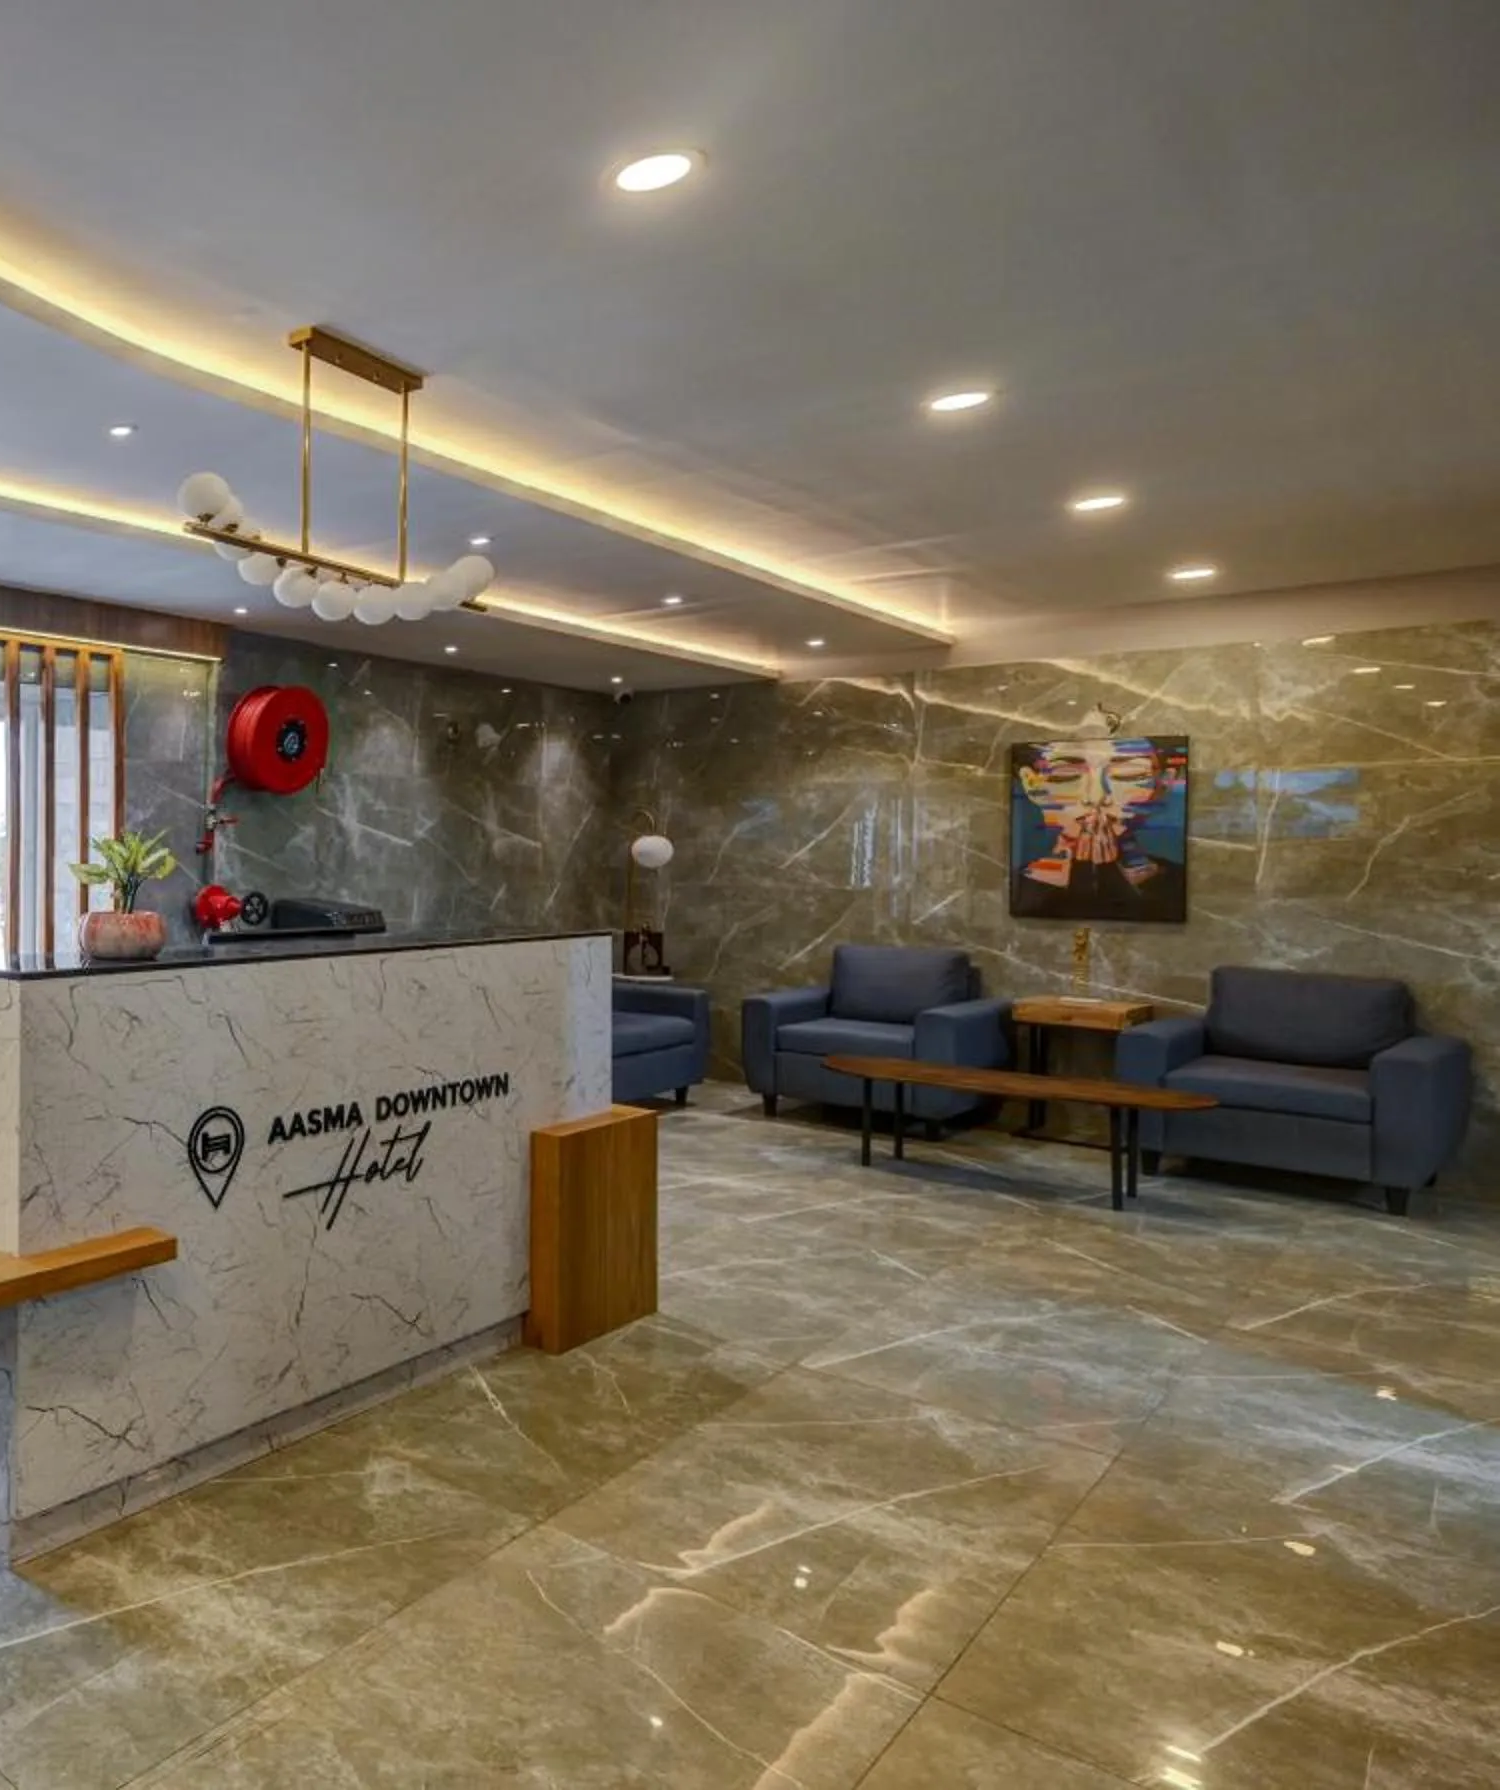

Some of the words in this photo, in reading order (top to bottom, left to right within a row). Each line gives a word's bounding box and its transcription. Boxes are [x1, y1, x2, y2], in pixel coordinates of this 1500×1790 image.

[268, 1102, 363, 1145] AASMA
[375, 1072, 509, 1122] DOWNTOWN
[282, 1120, 432, 1231] Hotel
